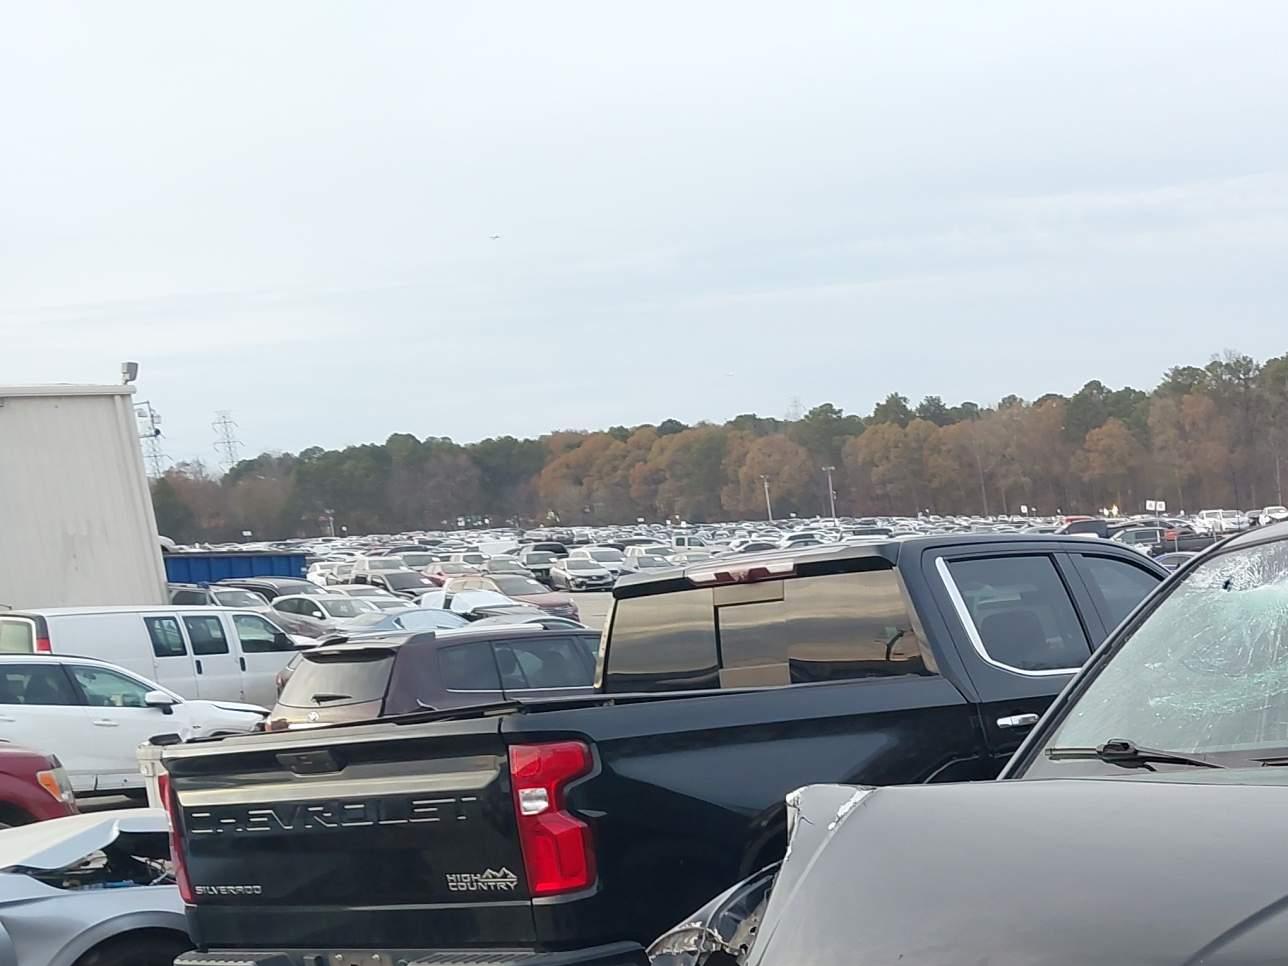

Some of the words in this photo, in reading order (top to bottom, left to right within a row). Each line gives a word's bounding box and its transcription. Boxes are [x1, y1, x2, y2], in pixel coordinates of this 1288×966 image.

[191, 797, 477, 833] CHEVROLET
[446, 872, 481, 884] HIGH
[194, 884, 263, 896] SILVERADO
[447, 879, 518, 892] COUNTRY
